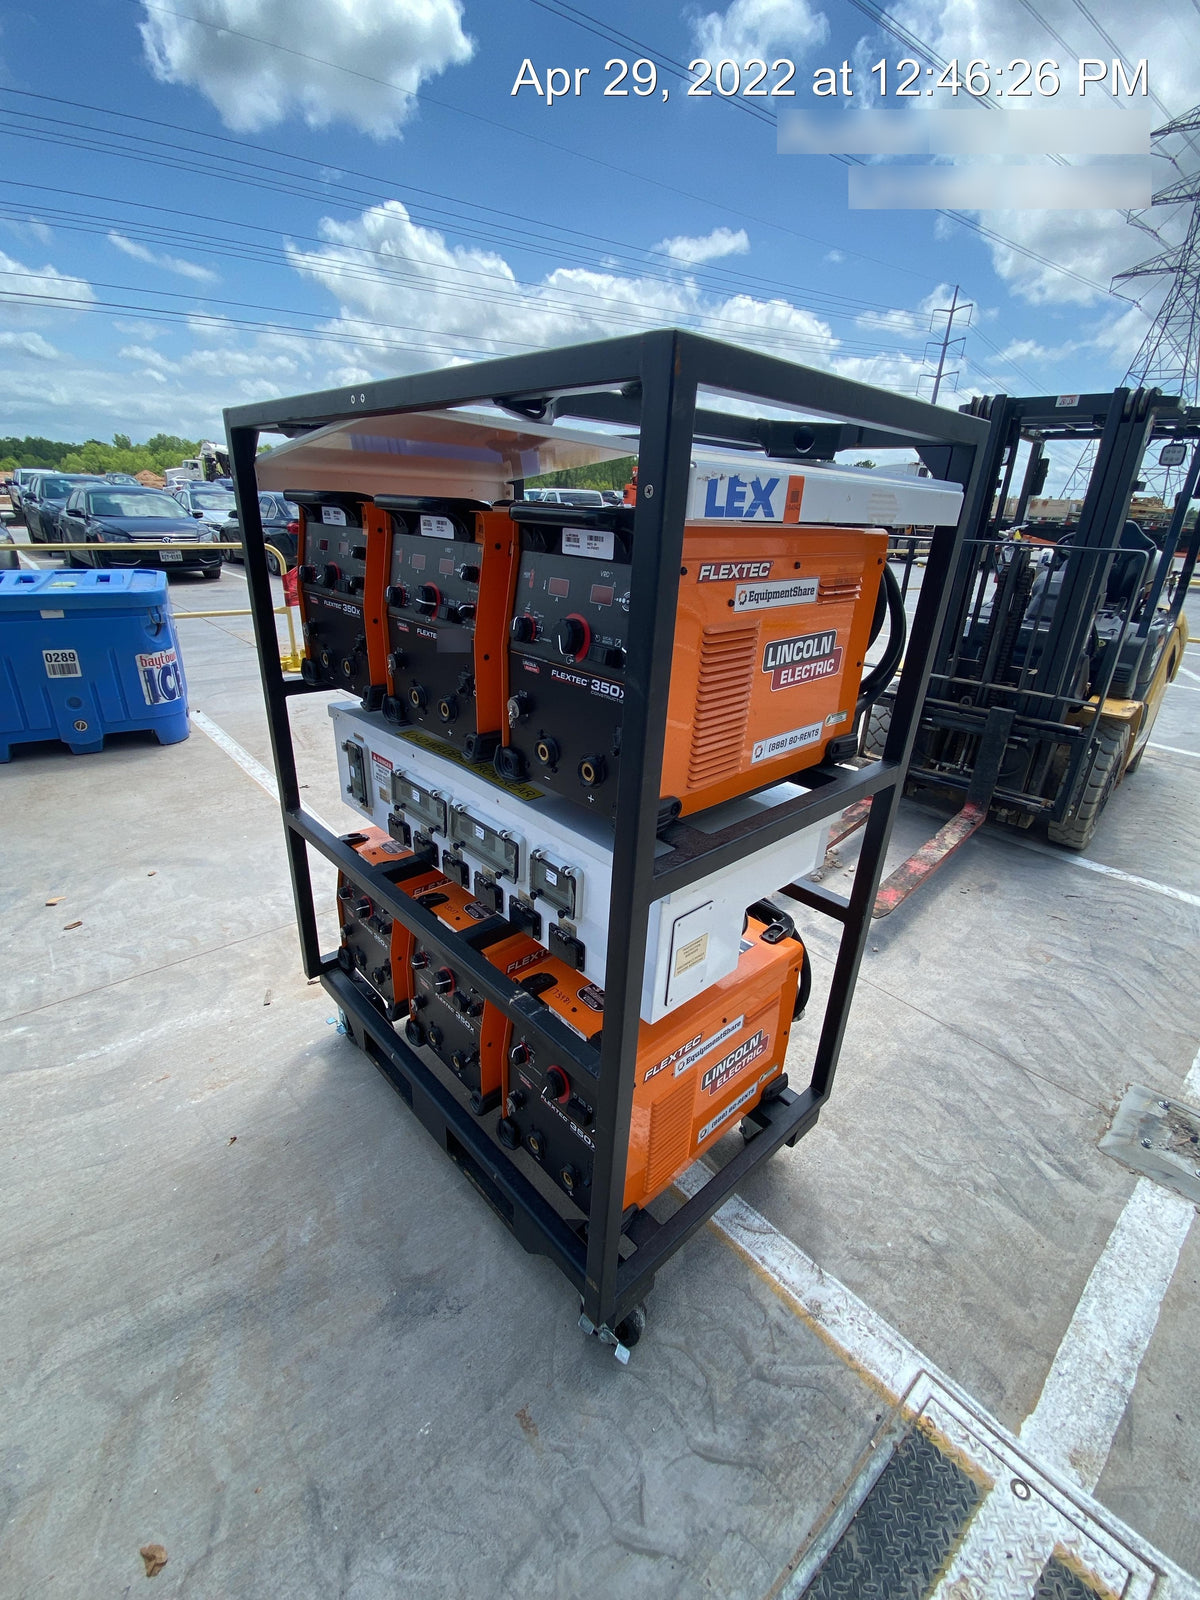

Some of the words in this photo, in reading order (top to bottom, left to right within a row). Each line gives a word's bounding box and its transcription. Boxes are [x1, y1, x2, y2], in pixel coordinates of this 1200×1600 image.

[704, 475, 780, 518] LEX
[699, 562, 770, 581] FLEXTEC
[747, 585, 815, 604] EquipmentShare
[44, 652, 76, 664] 0289
[766, 635, 833, 668] LINCOLN
[551, 669, 588, 686] FLEXTEC
[780, 658, 835, 685] ELECTRIC
[506, 948, 549, 974] FLEXT
[644, 1034, 702, 1082] FLEXTEC
[704, 1033, 760, 1087] LINCOLN
[716, 1045, 764, 1088] ELECTRIC
[540, 1094, 569, 1122] FLEXTEC
